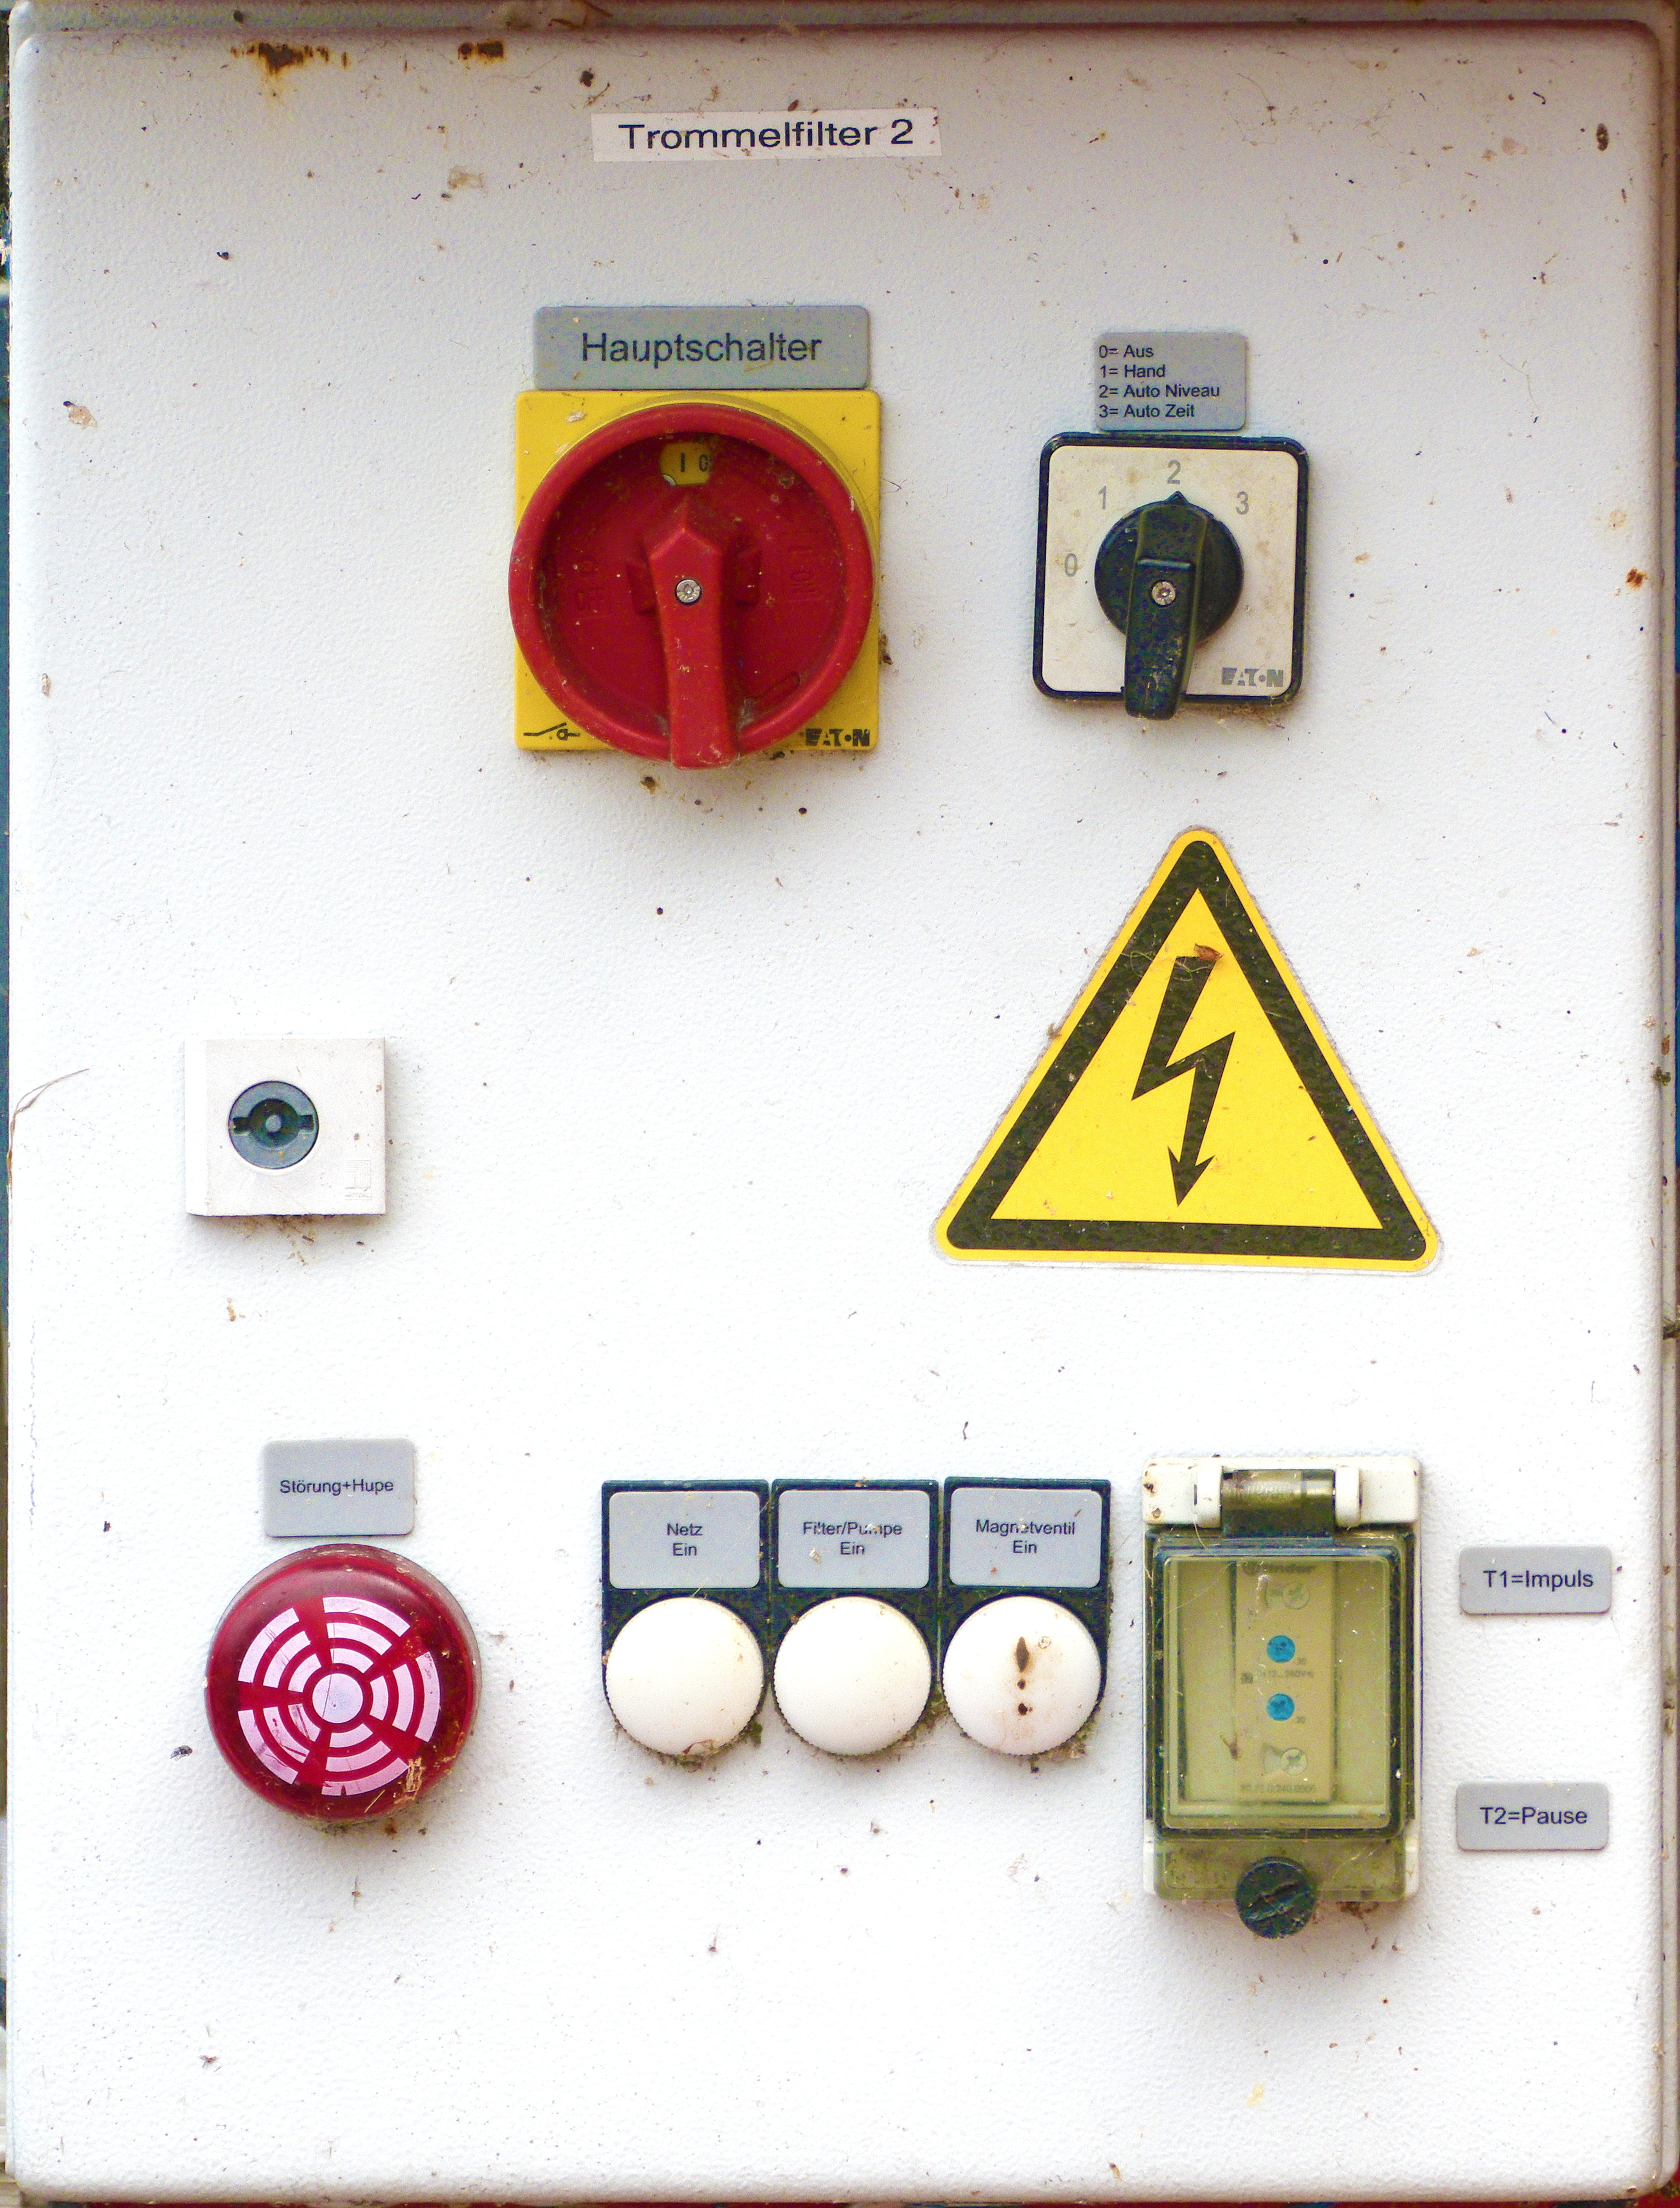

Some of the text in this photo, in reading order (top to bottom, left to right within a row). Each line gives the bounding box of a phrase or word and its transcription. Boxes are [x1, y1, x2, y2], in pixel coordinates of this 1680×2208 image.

[618, 119, 913, 150] Trommelfilter 2
[582, 332, 822, 368] Hauptschalter
[1099, 344, 1154, 358] 0= Aus
[1100, 364, 1166, 378] 1= Hand
[1099, 383, 1220, 398] 2= Auto Niveau
[1099, 404, 1195, 418] 3= Auto Zeit
[1166, 459, 1182, 484] 2
[1098, 485, 1108, 510] 1
[1236, 491, 1250, 515] 3
[1064, 553, 1078, 578] 0
[280, 1478, 394, 1496] Störung+Hupe
[667, 1523, 703, 1536] Netz
[803, 1520, 902, 1538] Filter/Pumpe
[976, 1518, 1076, 1537] Magnetventil
[673, 1542, 697, 1556] Ein
[840, 1542, 866, 1555] Ein
[1013, 1540, 1038, 1554] Ein
[1483, 1570, 1594, 1592] T1=Impuls
[1480, 1806, 1588, 1824] T2=Pause
